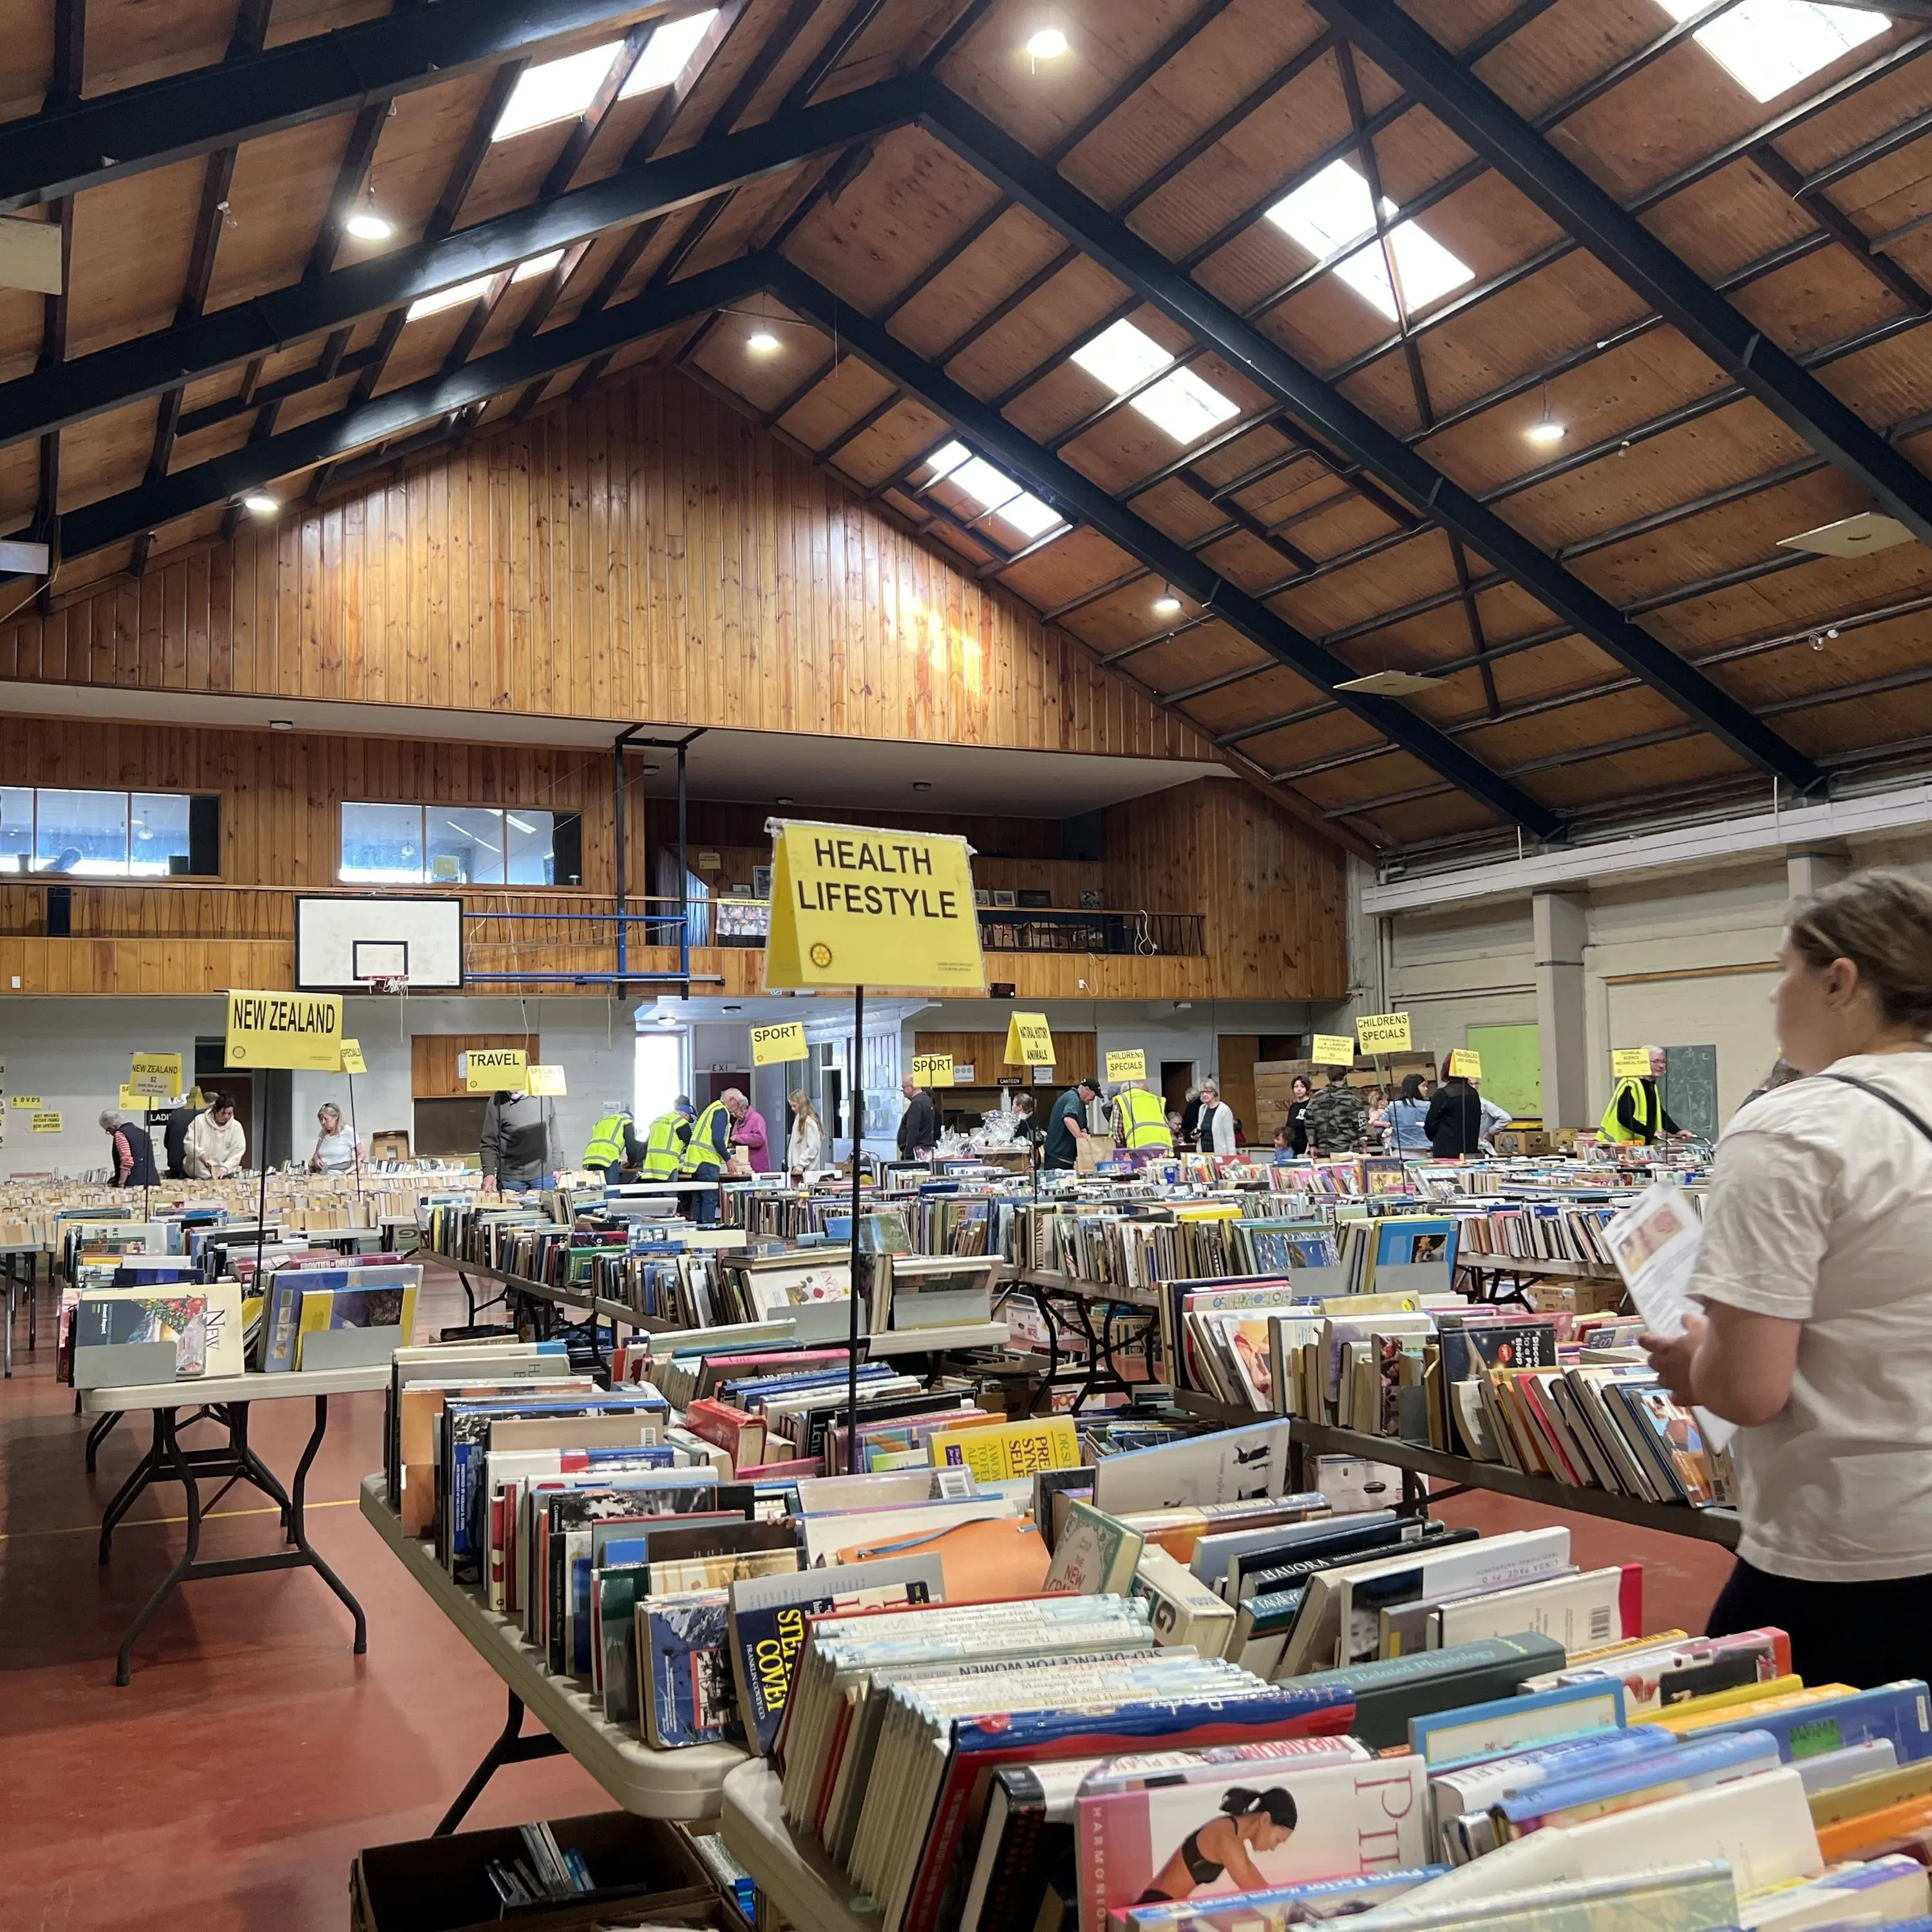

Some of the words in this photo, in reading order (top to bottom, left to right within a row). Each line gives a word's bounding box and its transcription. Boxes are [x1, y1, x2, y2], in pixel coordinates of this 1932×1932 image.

[815, 837, 932, 875] HEALTH
[797, 880, 958, 919] LIFESTYLE
[234, 999, 267, 1030] NEW
[269, 1001, 335, 1033] ZEALAND
[1358, 1014, 1407, 1028] CHILDRENS
[754, 1026, 797, 1042] SPORT
[1363, 1028, 1405, 1041] SPECIALS
[341, 1048, 362, 1058] SPECIALS
[469, 1054, 519, 1066] TRAVEL
[1027, 1050, 1048, 1060] ANIMALS
[1107, 1052, 1143, 1060] CHILDRENS
[132, 1065, 147, 1073] NEW
[147, 1065, 178, 1074] ZEALAND
[913, 1059, 951, 1072] SPORT
[1110, 1061, 1142, 1071] SPECIALS
[300, 1260, 330, 1269] FRONTIER
[206, 1309, 225, 1350] NEW
[1260, 1558, 1329, 1580] HAUORA
[1507, 1567, 1529, 1577] PAGE
[1533, 1559, 1558, 1571] LINDA
[1064, 1564, 1086, 1589] NEW
[1027, 1658, 1056, 1669] FOR
[1059, 1649, 1162, 1665] SELF-DEFENCE
[959, 1661, 1022, 1676] WOMEN
[1355, 1662, 1415, 1681] Related
[1415, 1650, 1495, 1670] Physiology
[746, 1643, 757, 1681] FRANKLIN
[752, 1681, 763, 1707] COVEY
[755, 1639, 788, 1711] COVEY
[1021, 1681, 1069, 1690] Managing
[1032, 1689, 1068, 1698] Natural
[1071, 1685, 1119, 1694] Remedies
[1043, 1698, 1077, 1706] Health
[1080, 1694, 1101, 1703] And
[1240, 1736, 1347, 1761] MAXIMUM
[1368, 1868, 1425, 1884] Phyto
[1305, 1875, 1366, 1893] Factor
